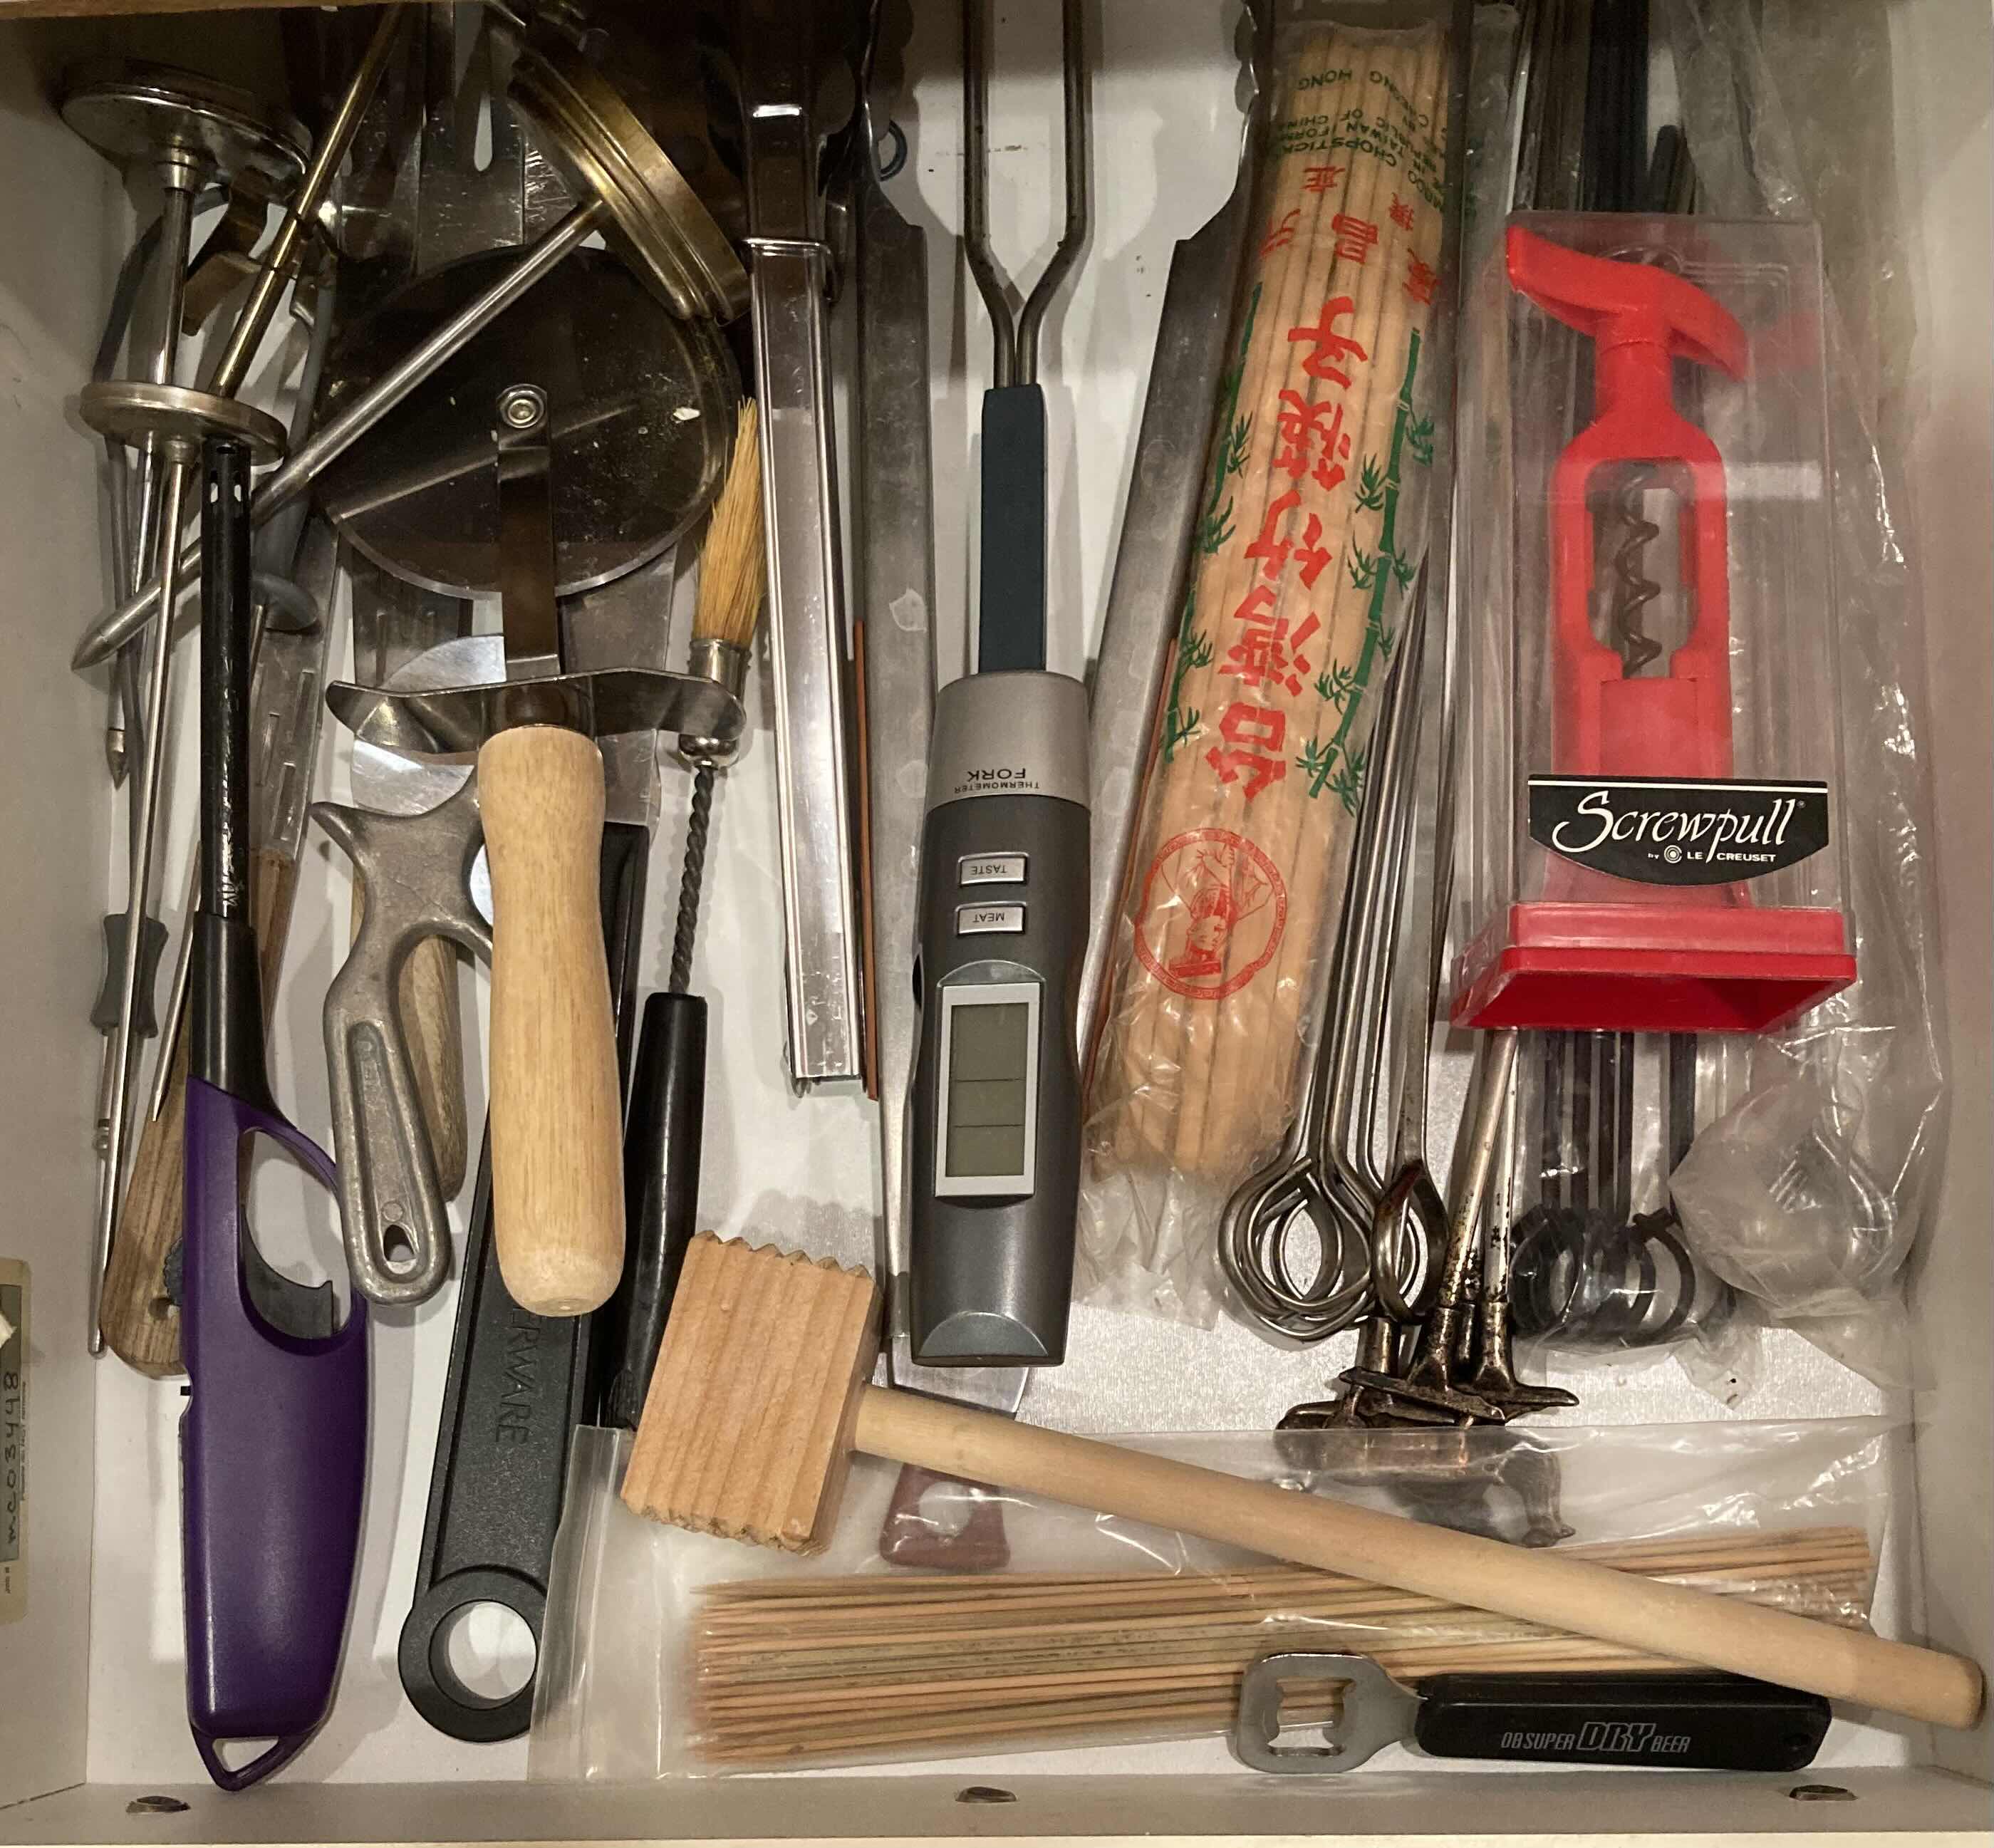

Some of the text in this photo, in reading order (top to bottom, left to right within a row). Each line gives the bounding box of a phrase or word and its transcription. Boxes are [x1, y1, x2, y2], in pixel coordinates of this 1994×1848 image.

[1298, 70, 1351, 90] HONG
[1346, 123, 1404, 157] TAIWAN
[967, 767, 1027, 781] FORK
[954, 781, 1039, 794] THERMOMETER
[1552, 789, 1797, 863] Screwpull
[1686, 851, 1705, 861] LE
[1716, 851, 1777, 863] CREUSET
[970, 864, 1008, 876] TASTE
[972, 911, 1005, 923] MEAT
[1577, 1720, 1657, 1753] DRY
[1650, 1735, 1692, 1754] BEER
